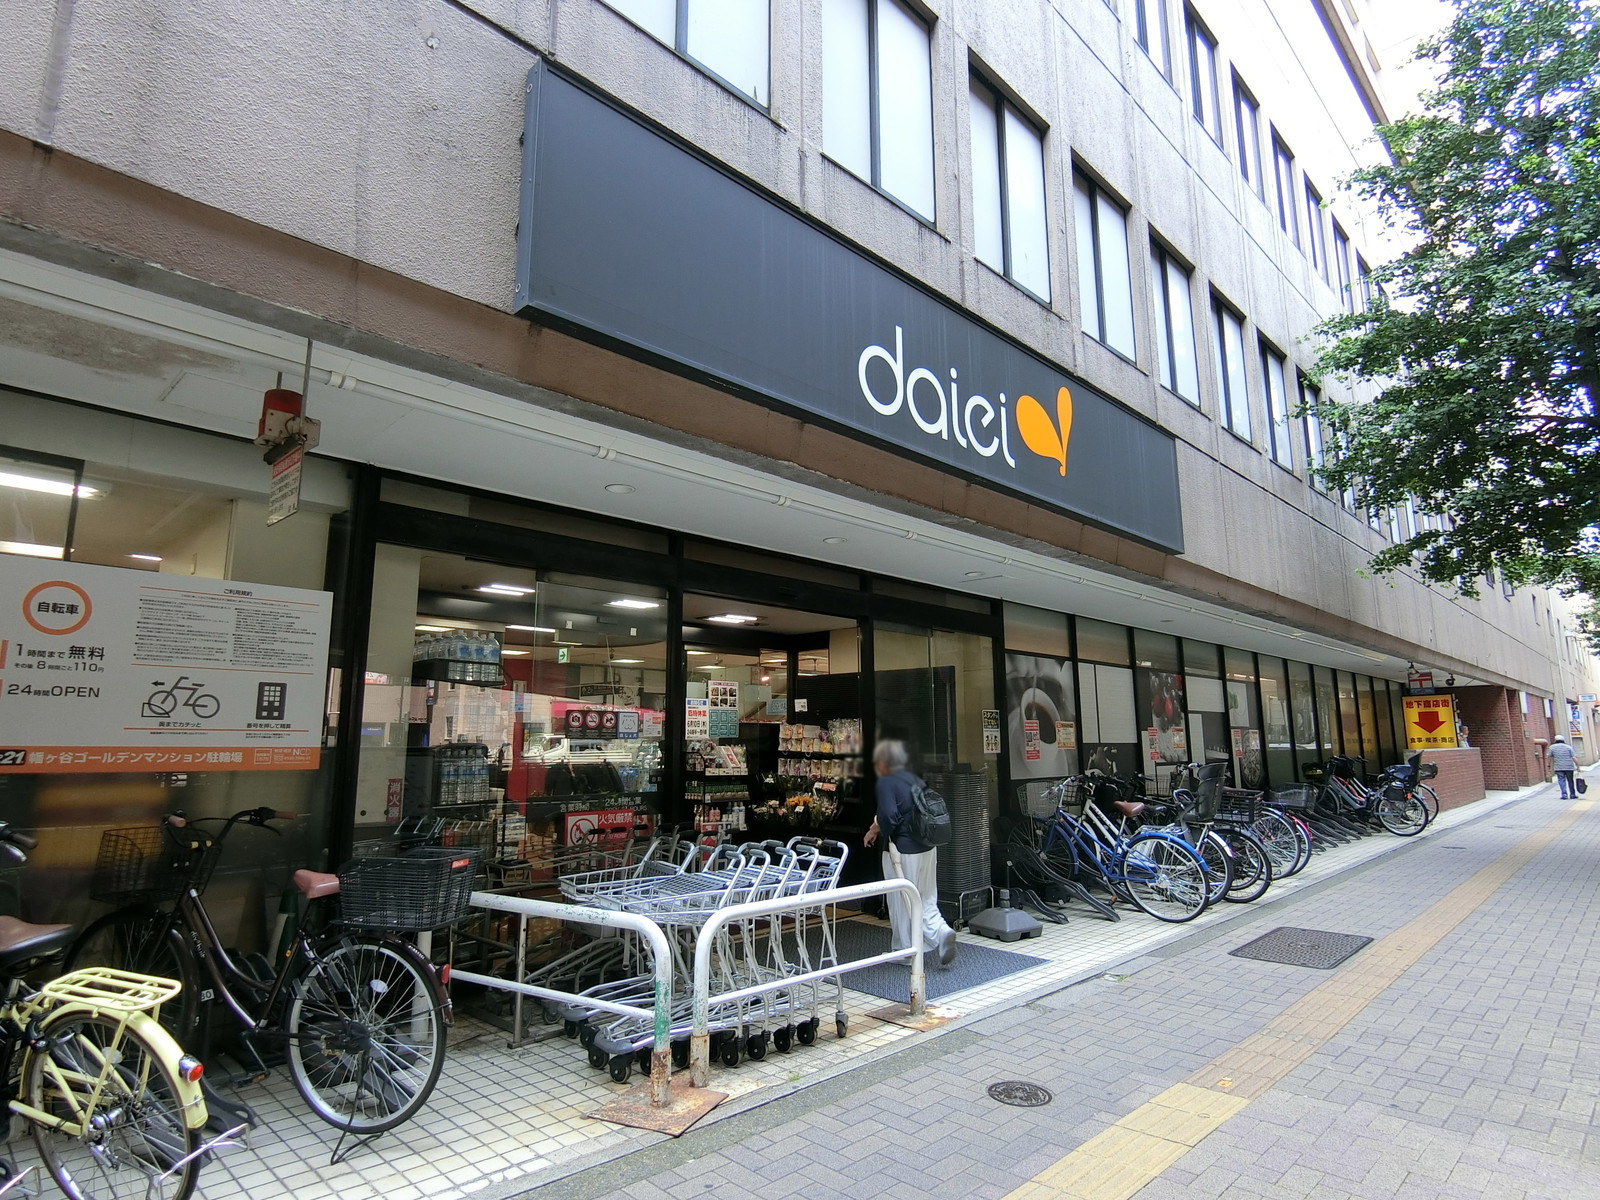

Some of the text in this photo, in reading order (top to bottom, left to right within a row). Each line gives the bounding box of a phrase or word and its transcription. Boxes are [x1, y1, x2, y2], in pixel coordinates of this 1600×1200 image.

[858, 325, 1016, 468] daiei
[37, 602, 79, 615] 自転車
[1405, 699, 1450, 709] 地下商店街
[389, 782, 401, 818] 消火器
[599, 812, 633, 825] 火気厳禁
